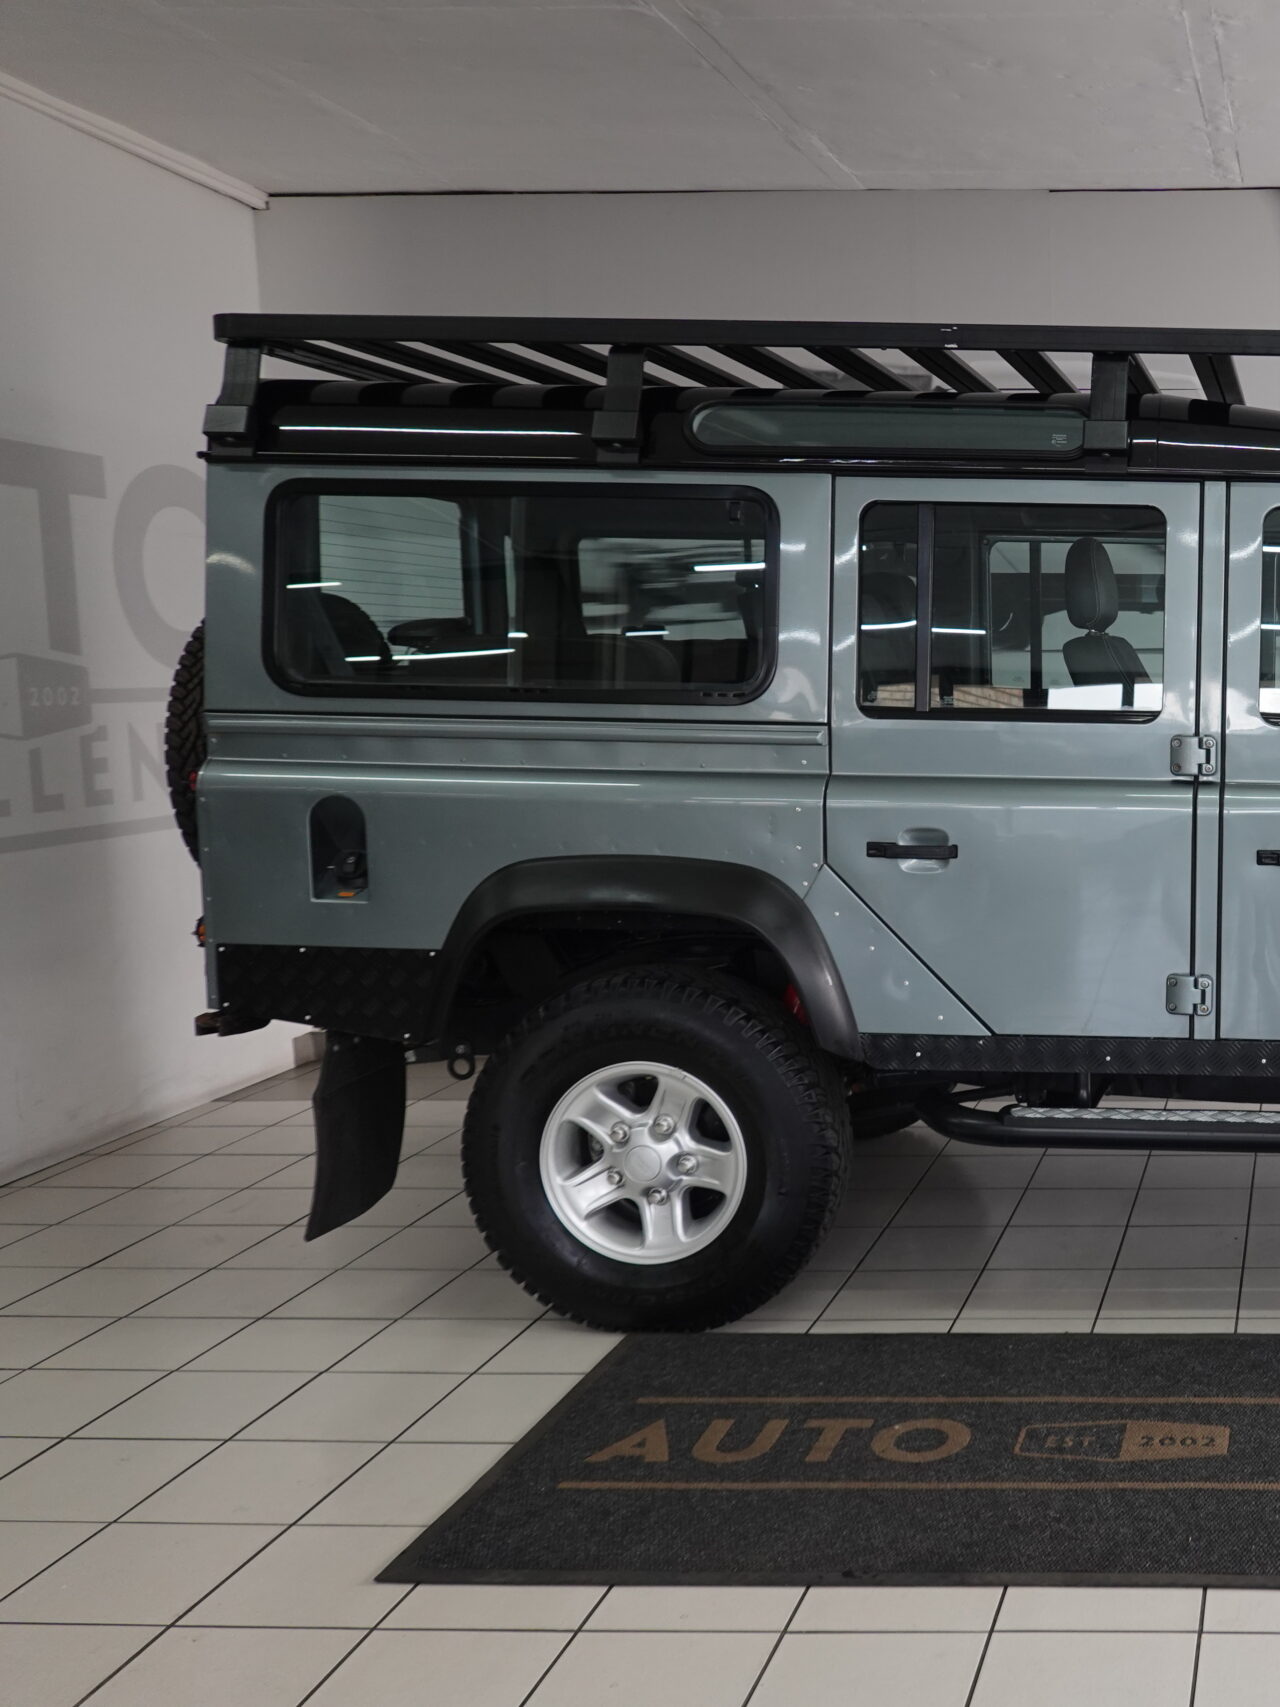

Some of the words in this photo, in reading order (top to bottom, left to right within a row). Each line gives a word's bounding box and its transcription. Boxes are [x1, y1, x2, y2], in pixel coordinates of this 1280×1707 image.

[29, 685, 81, 707] 2002
[0, 719, 167, 817] LEN
[583, 1418, 973, 1464] AUTO
[1044, 1435, 1096, 1448] EST
[1138, 1435, 1216, 1448] 2002
